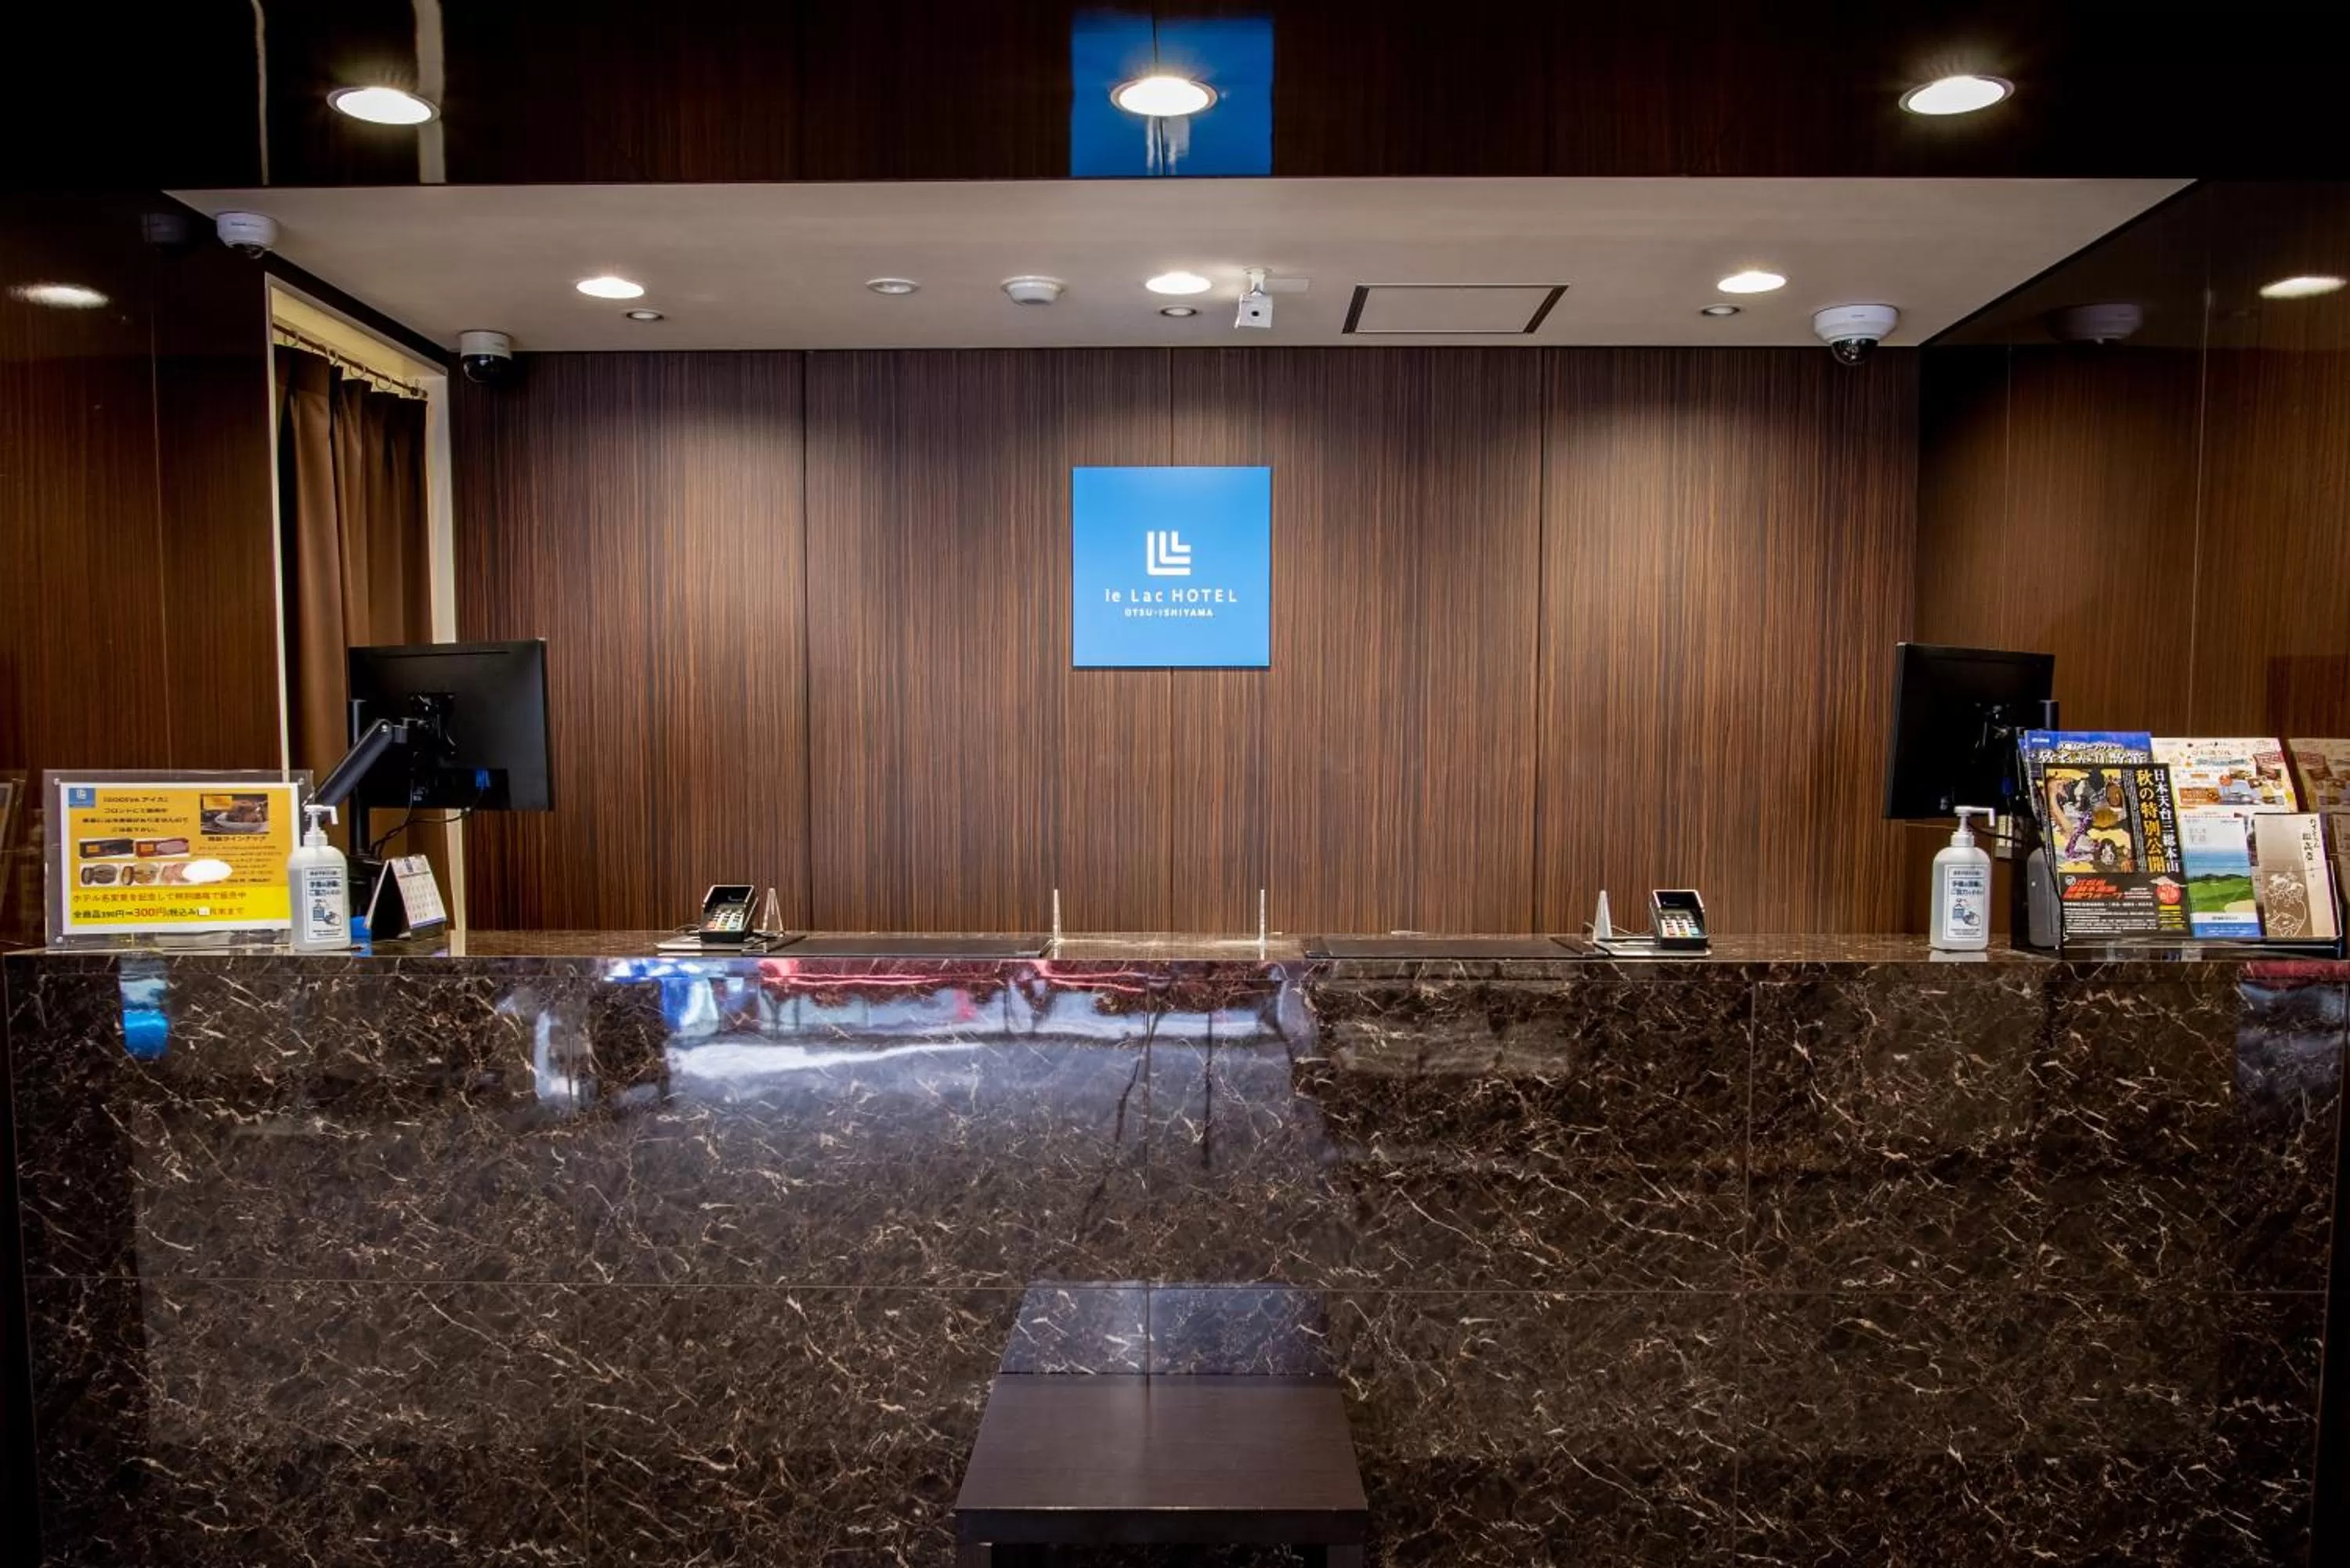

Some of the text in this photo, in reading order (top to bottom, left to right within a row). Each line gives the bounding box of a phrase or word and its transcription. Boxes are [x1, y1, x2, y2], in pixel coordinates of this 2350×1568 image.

[1104, 588, 1238, 602] le Lac HOTEL
[1124, 608, 1213, 617] OTSU-ISHIYAMA
[2135, 769, 2166, 873] 秋の特別公開
